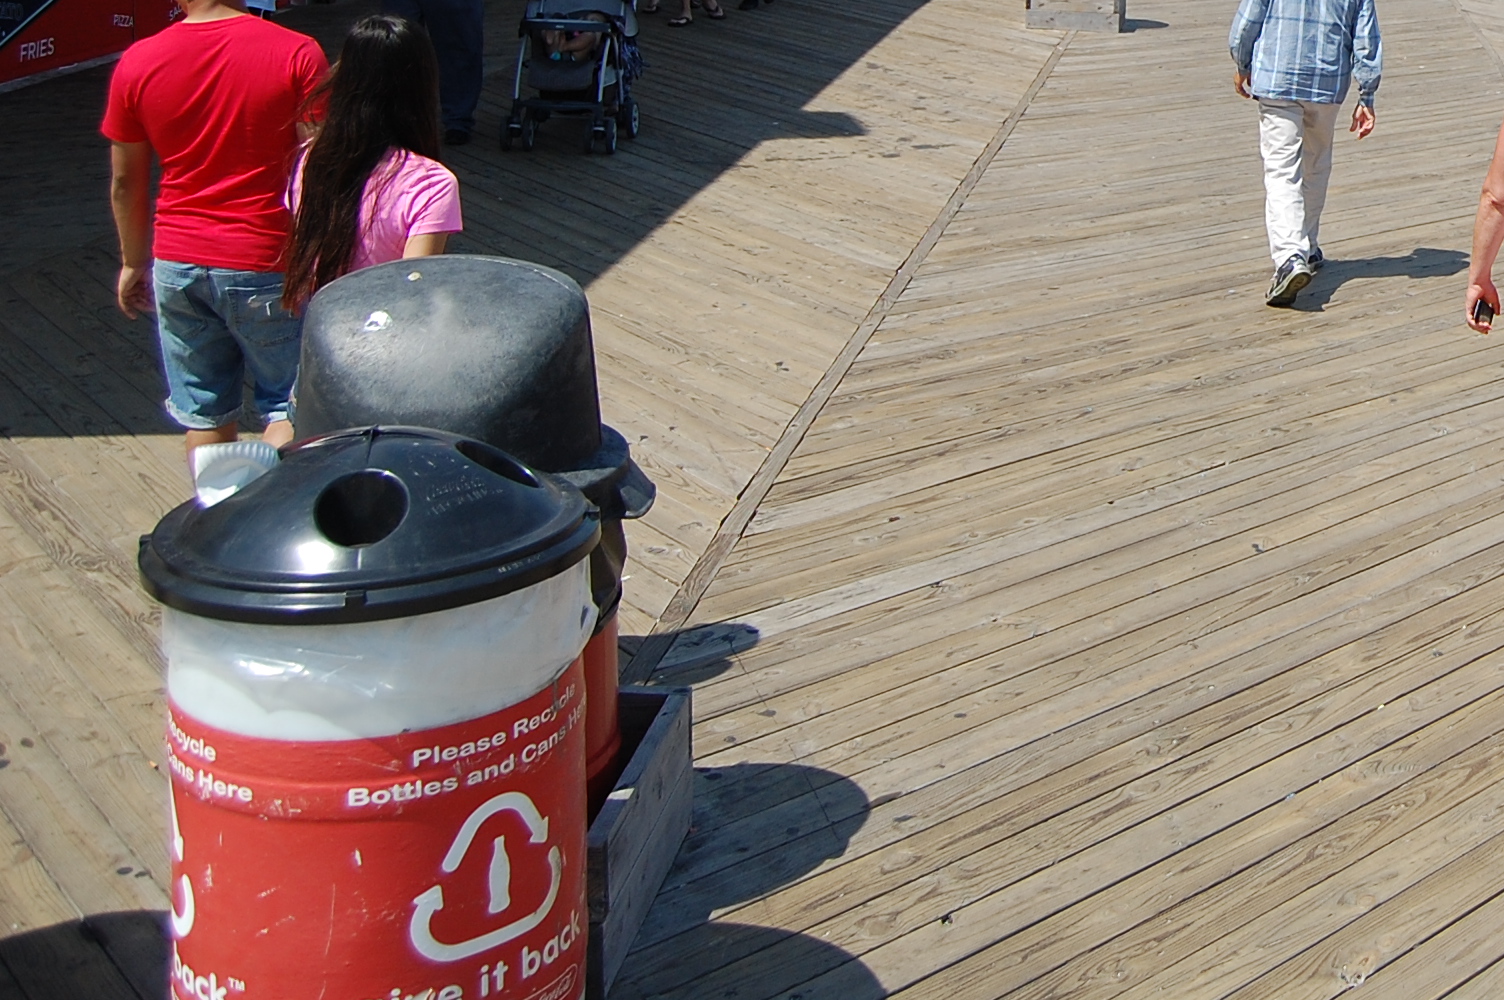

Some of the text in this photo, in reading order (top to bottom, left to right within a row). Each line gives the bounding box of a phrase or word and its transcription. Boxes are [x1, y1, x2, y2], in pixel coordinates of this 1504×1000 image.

[113, 14, 134, 28] PIZZA
[20, 37, 55, 63] FRIES
[168, 710, 216, 762] ecycle
[412, 683, 576, 768] Please Recycle
[199, 769, 253, 802] Here
[347, 776, 459, 807] Bottles
[467, 753, 516, 786] and
[522, 724, 567, 764] Cans
[480, 909, 581, 998] it back
